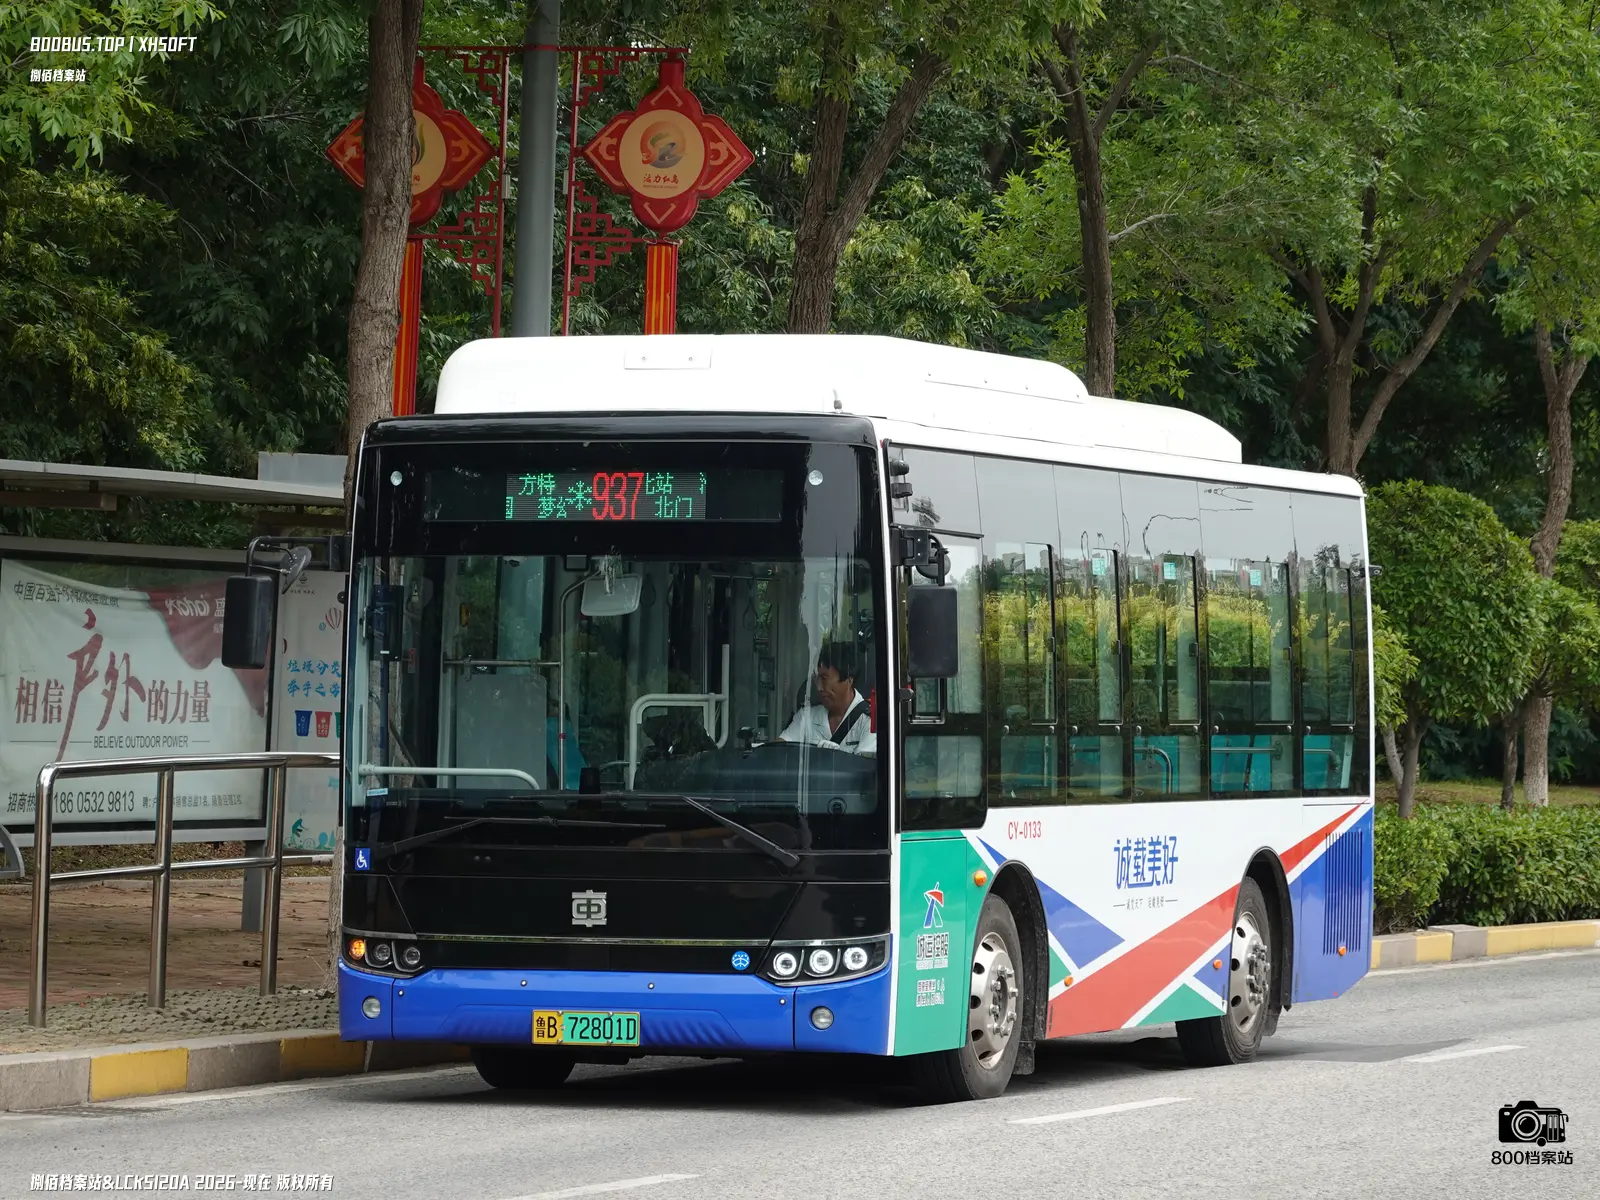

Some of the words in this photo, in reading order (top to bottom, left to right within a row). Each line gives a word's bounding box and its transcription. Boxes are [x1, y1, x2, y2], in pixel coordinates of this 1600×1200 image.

[518, 472, 556, 495] 方特
[592, 472, 645, 520] 937
[654, 495, 693, 519] 北门
[287, 679, 341, 698] 举手之劳
[93, 736, 124, 749] BELIEVE
[125, 736, 162, 749] OUTDOOR
[163, 735, 189, 749] POWER
[6, 791, 37, 813] 招商热
[53, 791, 74, 814] 186
[77, 790, 105, 813] 0532
[108, 790, 135, 812] 9813
[1008, 820, 1042, 840] CY-0133
[1113, 835, 1179, 890] 诚载美好
[568, 1016, 637, 1041] 72801D
